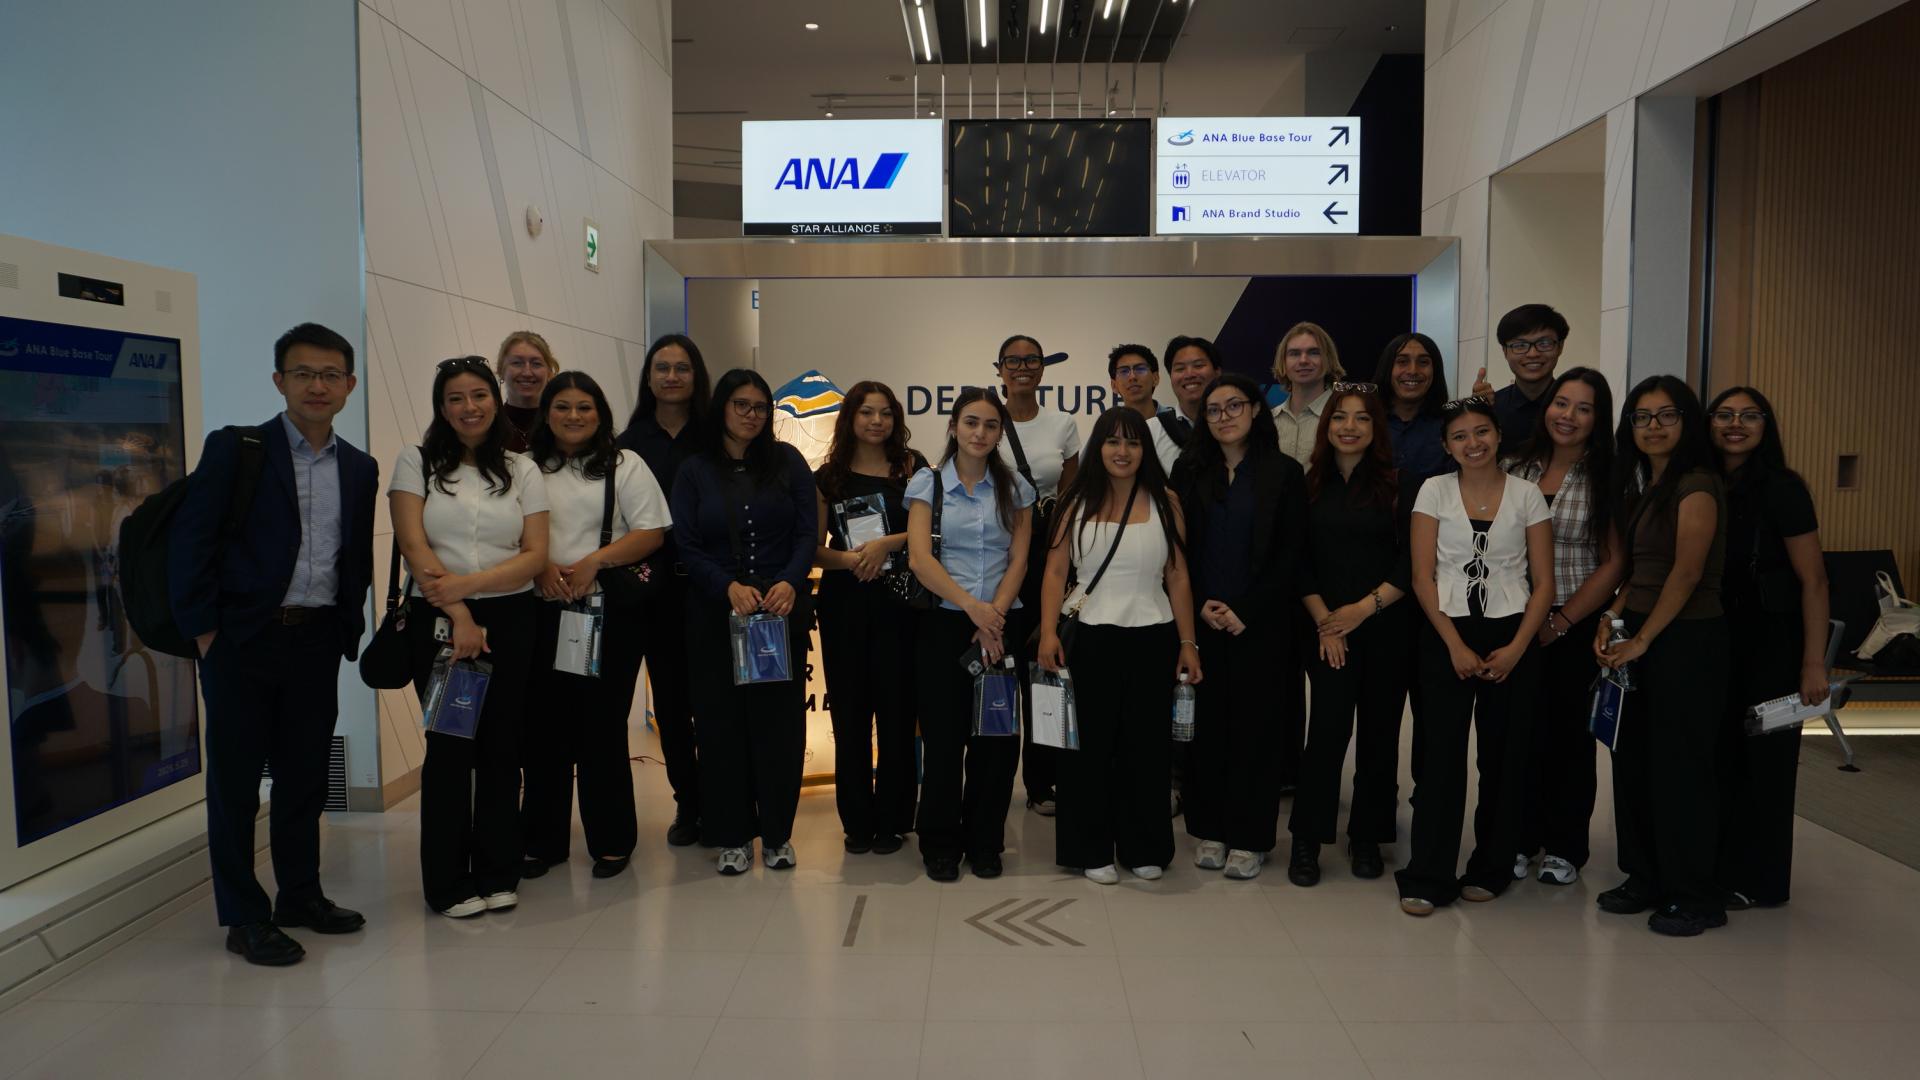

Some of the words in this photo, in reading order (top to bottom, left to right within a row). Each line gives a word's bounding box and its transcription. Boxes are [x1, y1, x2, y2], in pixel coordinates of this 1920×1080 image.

[1202, 133, 1228, 142] ANA
[1232, 133, 1255, 142] Blue
[1259, 133, 1285, 142] Base
[1288, 133, 1312, 142] Tour
[774, 157, 860, 190] ANA
[1201, 169, 1266, 182] ELEVATOR
[1202, 209, 1225, 219] ANA
[1229, 209, 1261, 218] Brand
[1265, 209, 1301, 218] Studio
[791, 224, 820, 233] STAR
[823, 224, 880, 233] ALLIANCE
[25, 343, 48, 355] ANA
[49, 345, 70, 358] Blue
[72, 347, 93, 359] Base
[94, 350, 113, 361] Tour
[128, 352, 155, 368] ANA
